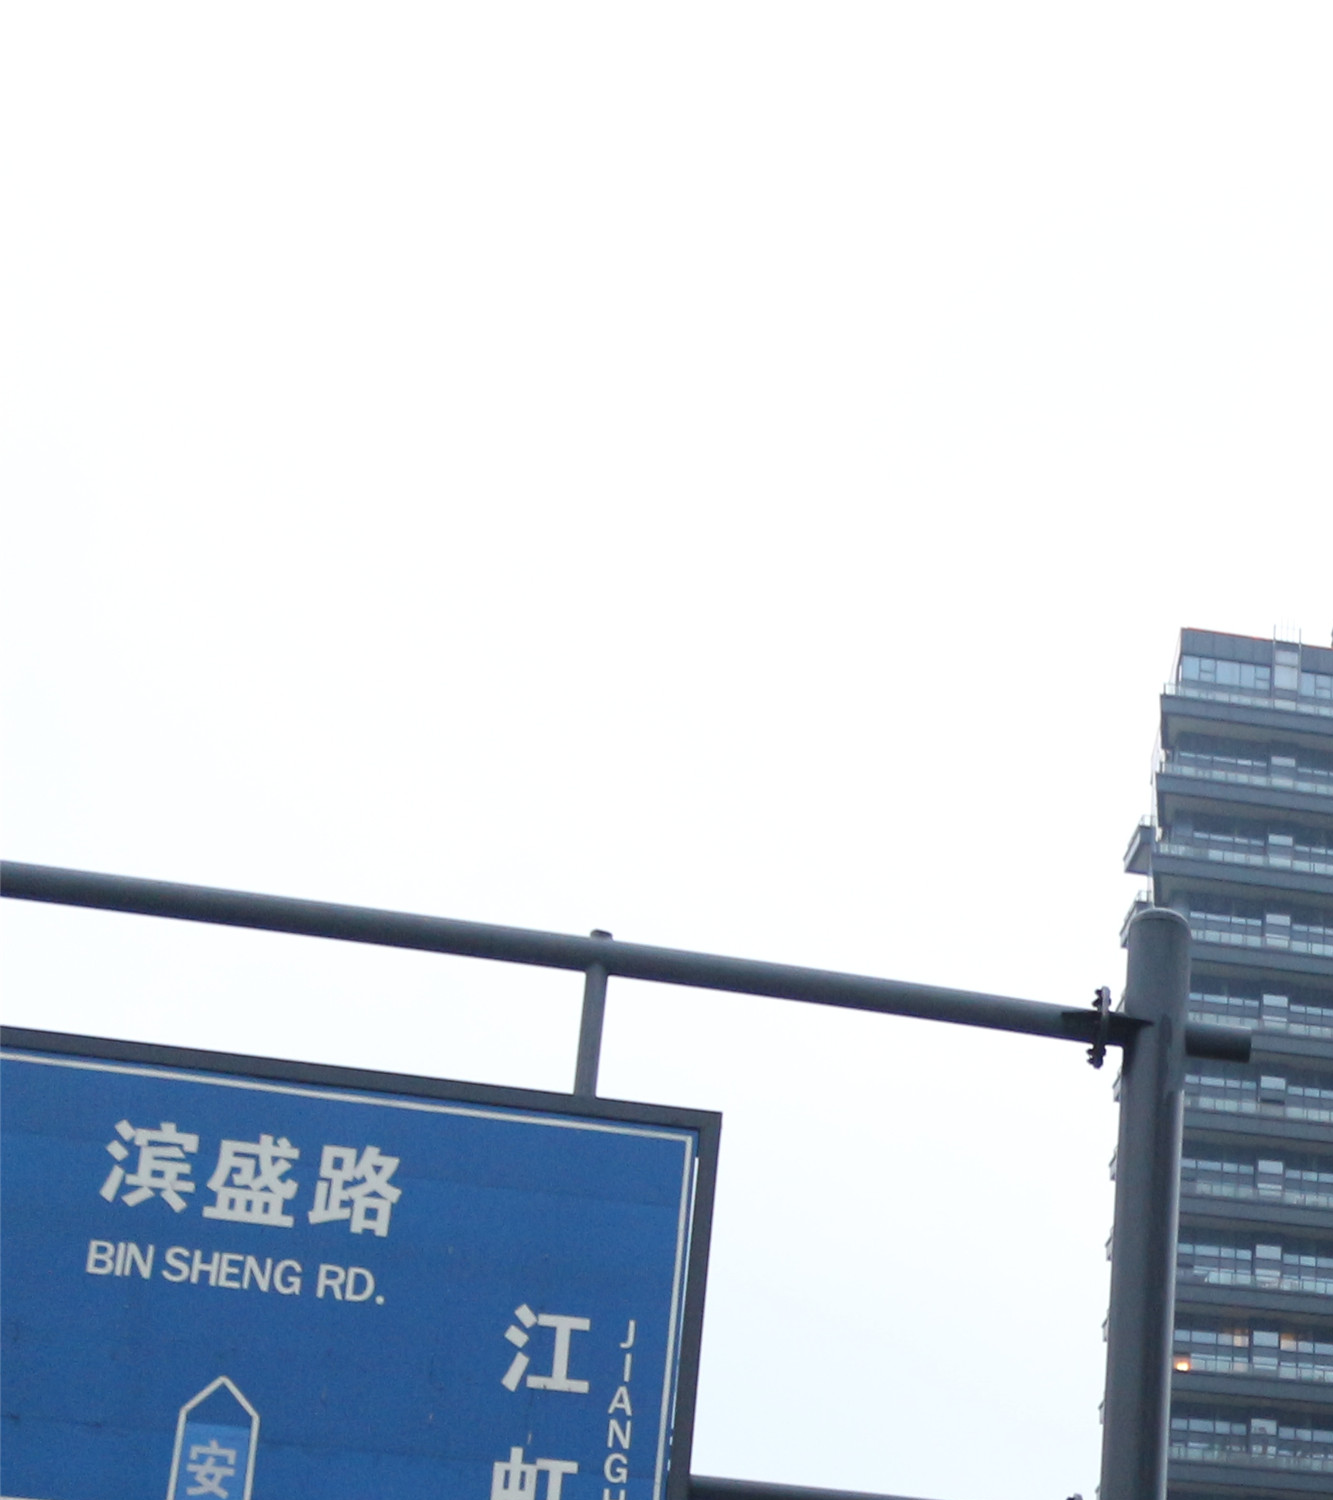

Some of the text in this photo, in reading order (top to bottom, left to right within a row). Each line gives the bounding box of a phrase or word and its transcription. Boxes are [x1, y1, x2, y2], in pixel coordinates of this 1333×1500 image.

[99, 1118, 402, 1237] 滨盛路
[86, 1239, 385, 1305] BIN SHENG RD.
